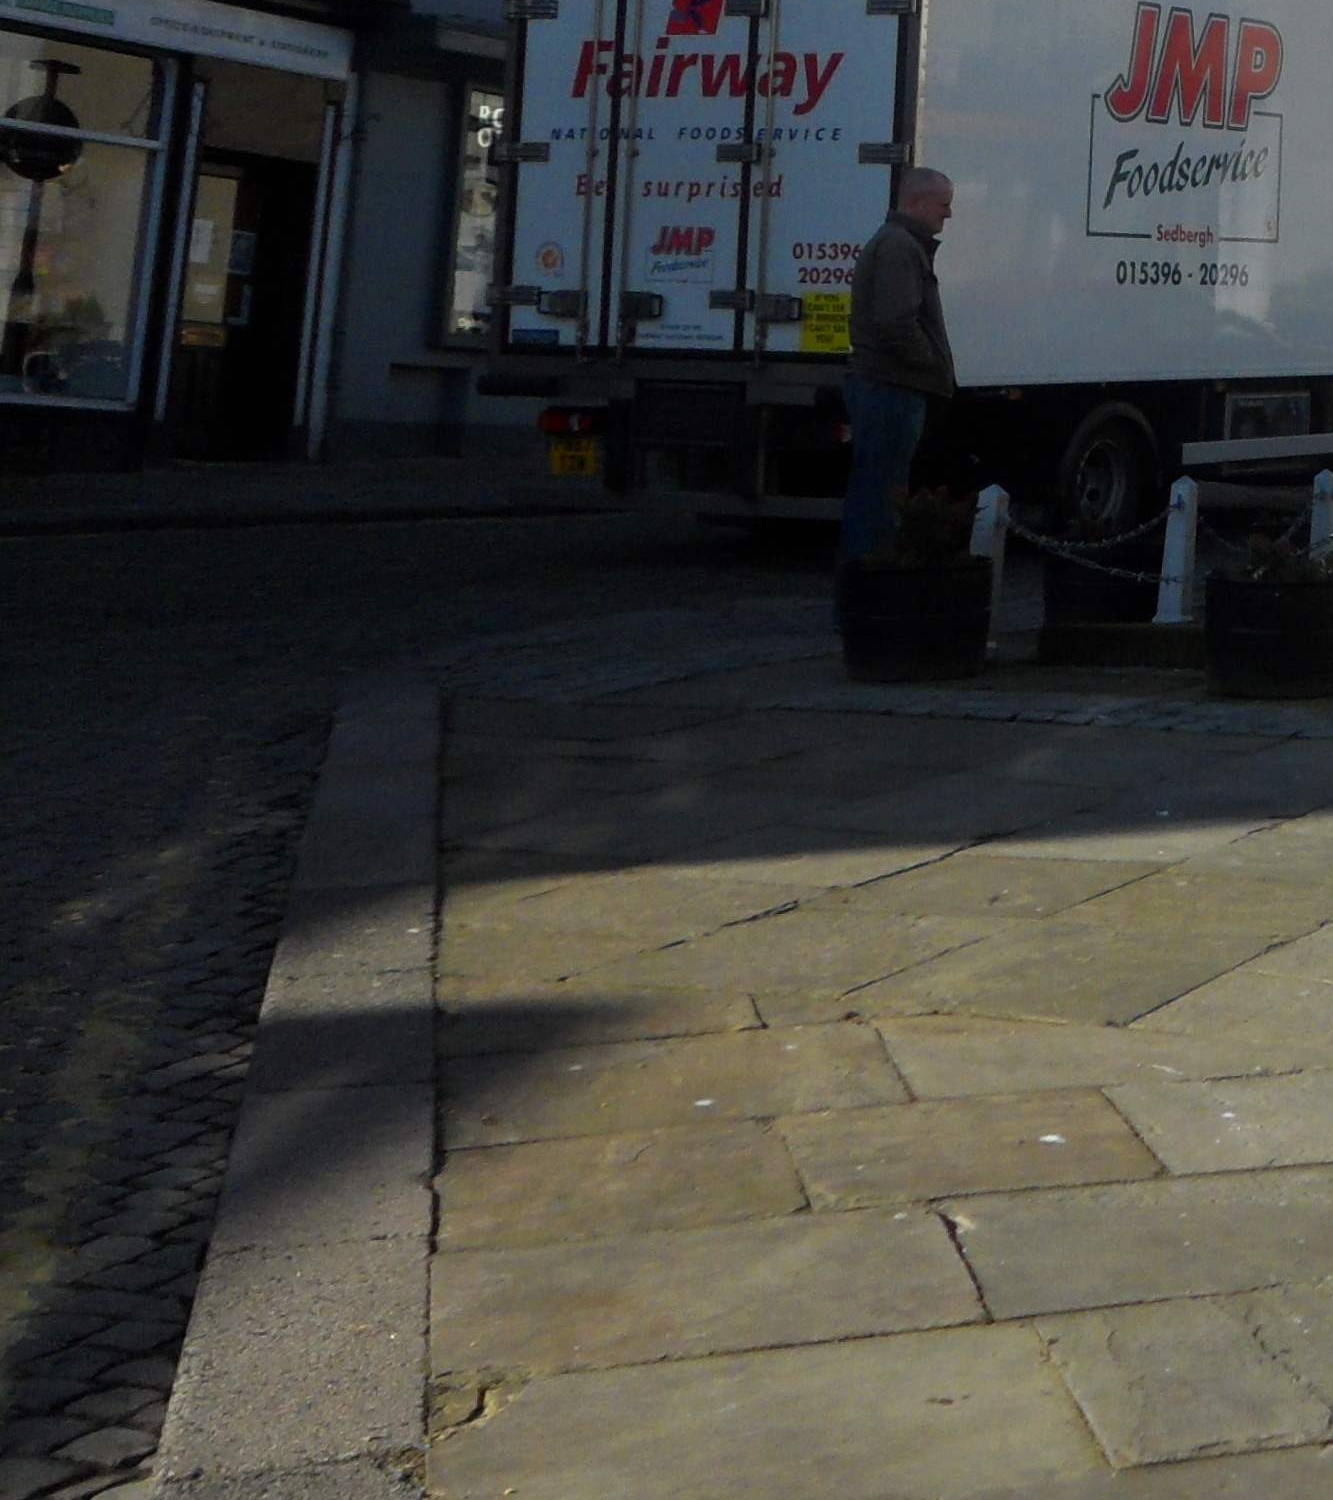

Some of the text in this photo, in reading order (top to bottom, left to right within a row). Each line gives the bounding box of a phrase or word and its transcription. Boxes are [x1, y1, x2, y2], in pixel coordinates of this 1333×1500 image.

[571, 36, 845, 116] Fairway
[1104, 1, 1284, 132] JMP
[551, 126, 843, 141] NATONAL FOODSERVICE
[642, 174, 784, 202] surprised
[1103, 140, 1269, 210] Foodservice
[650, 226, 716, 256] JMP
[1156, 224, 1214, 248] Sedbergh
[792, 242, 864, 261] 015396
[798, 266, 857, 285] 20296
[1116, 260, 1182, 285] 015396
[1199, 263, 1249, 287] 20296
